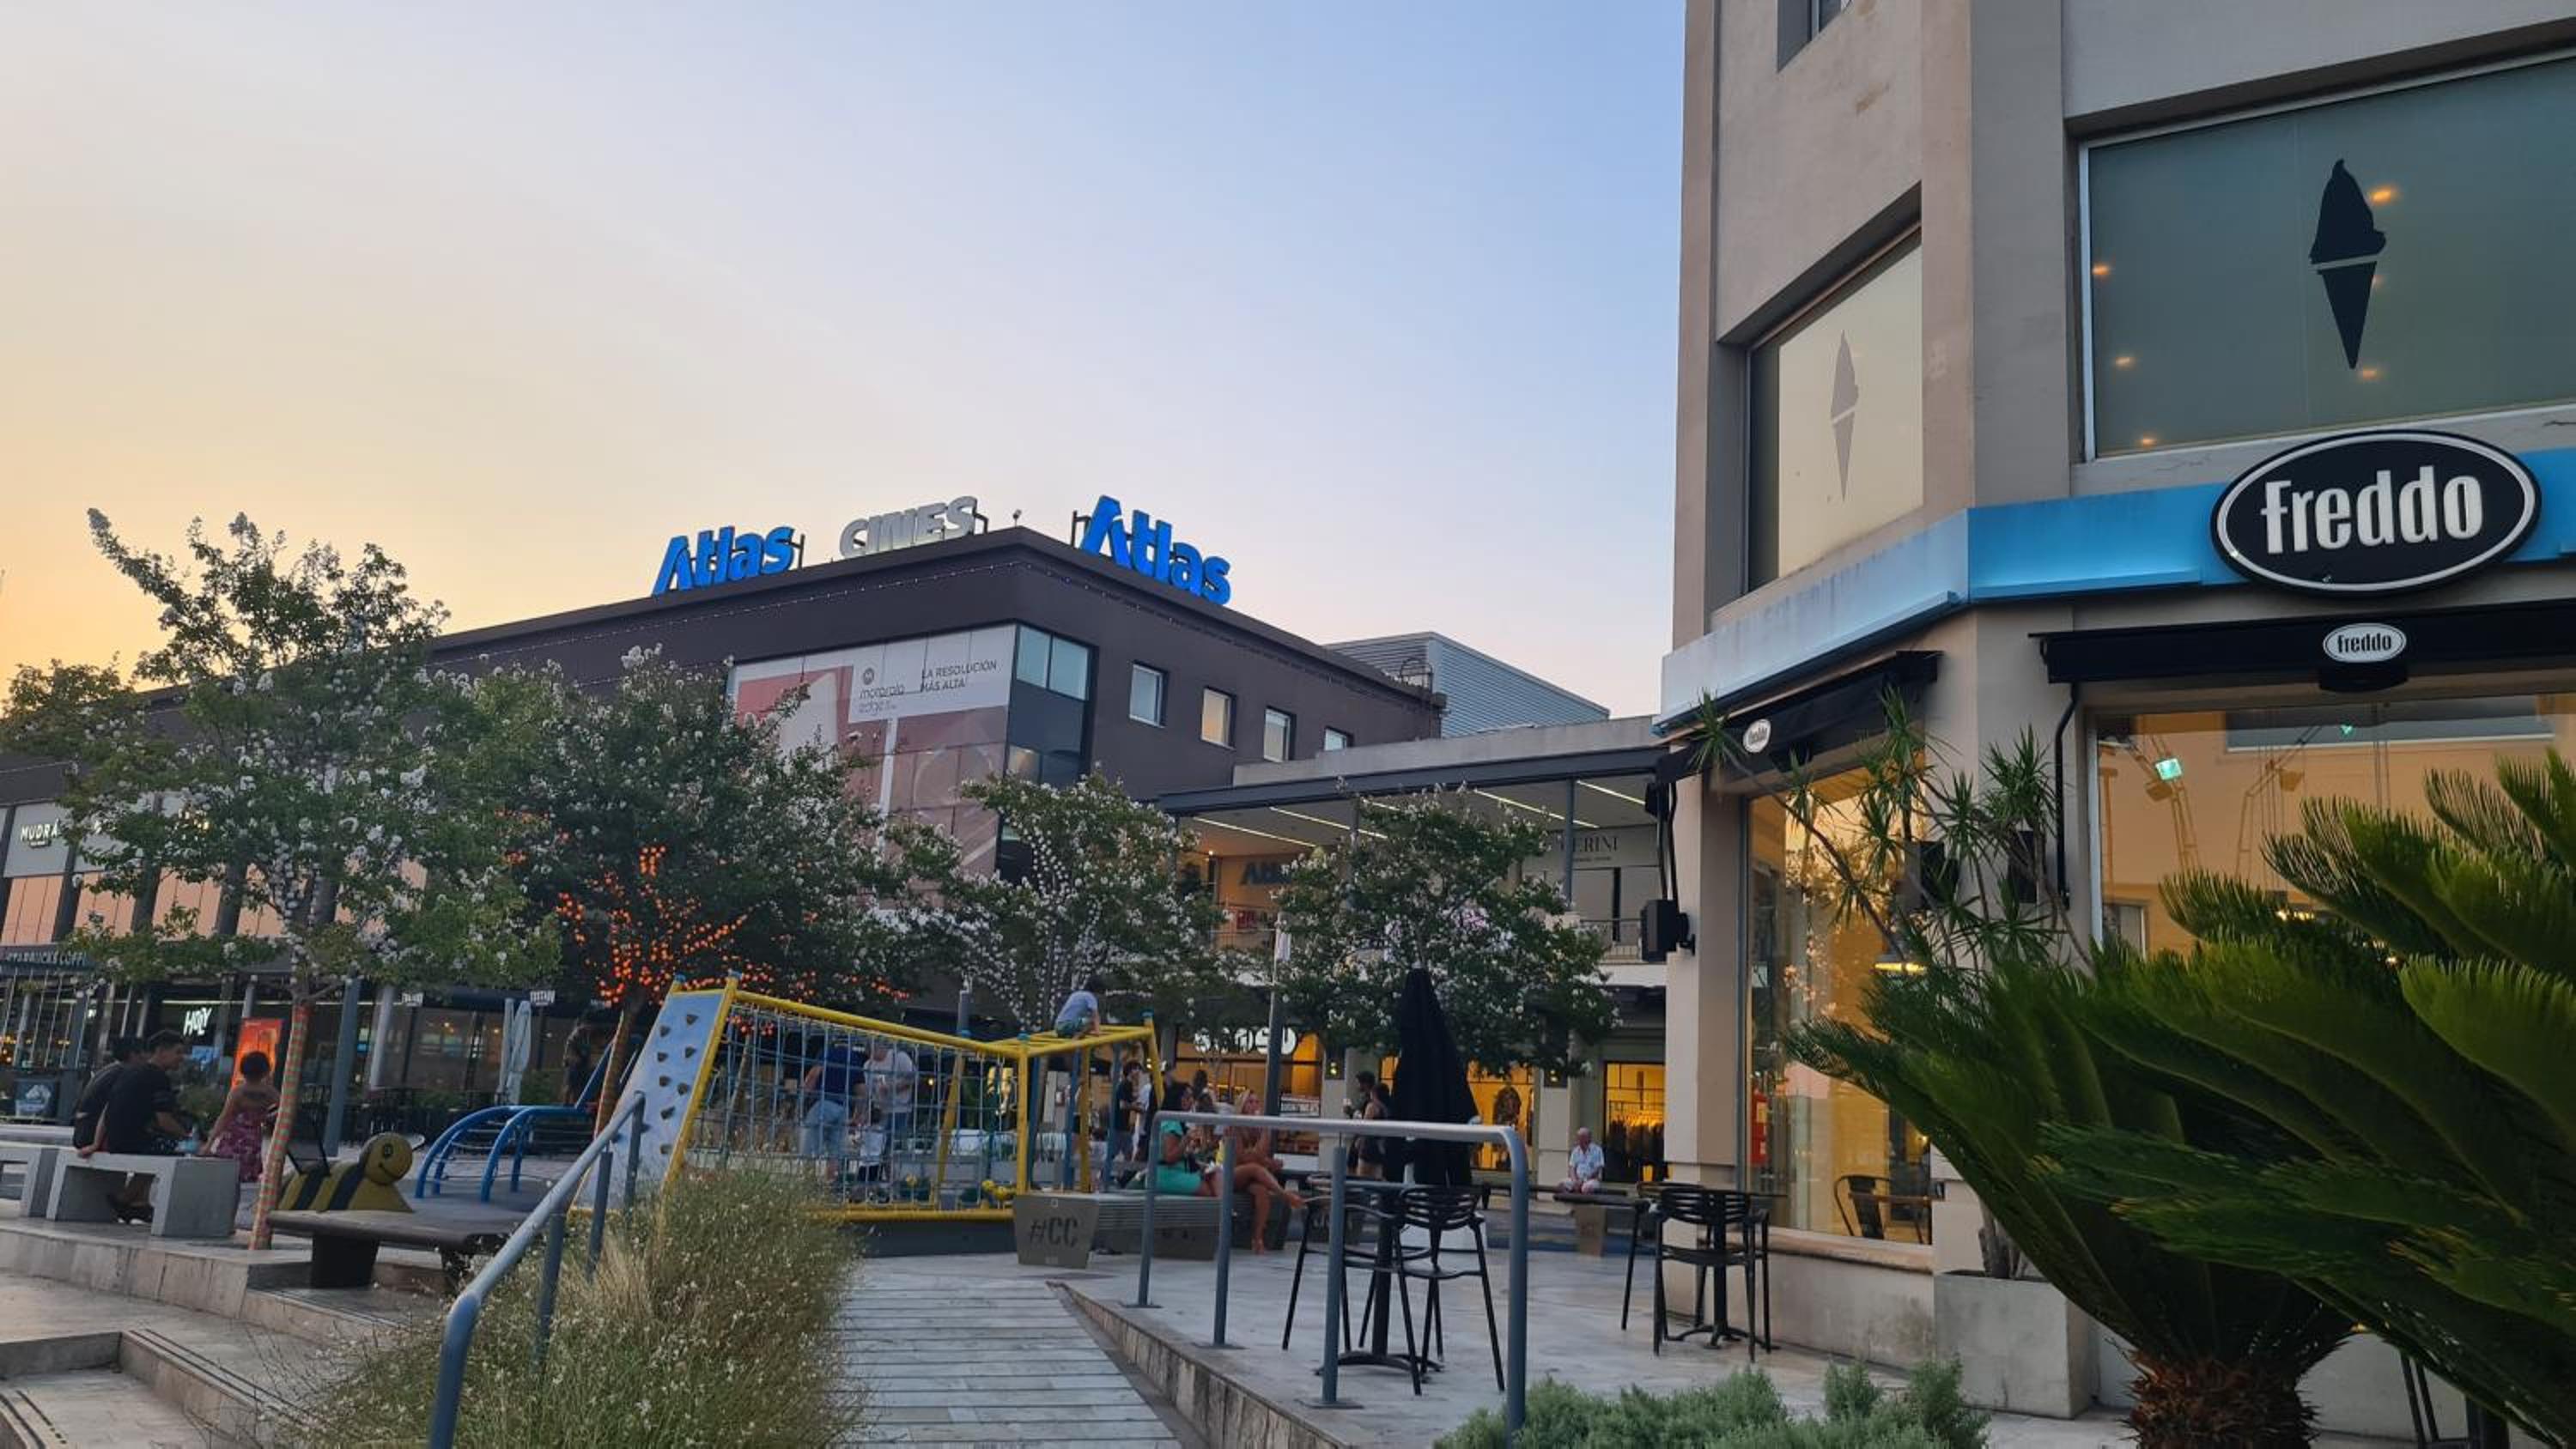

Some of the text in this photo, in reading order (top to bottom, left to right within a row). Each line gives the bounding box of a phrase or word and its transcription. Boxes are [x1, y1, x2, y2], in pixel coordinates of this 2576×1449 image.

[839, 495, 975, 559] CINES
[2260, 465, 2482, 555] freddo
[652, 525, 795, 597] Atlas
[1079, 494, 1231, 605] Atlas
[2337, 633, 2391, 653] freddo
[183, 1007, 212, 1035] HOLY
